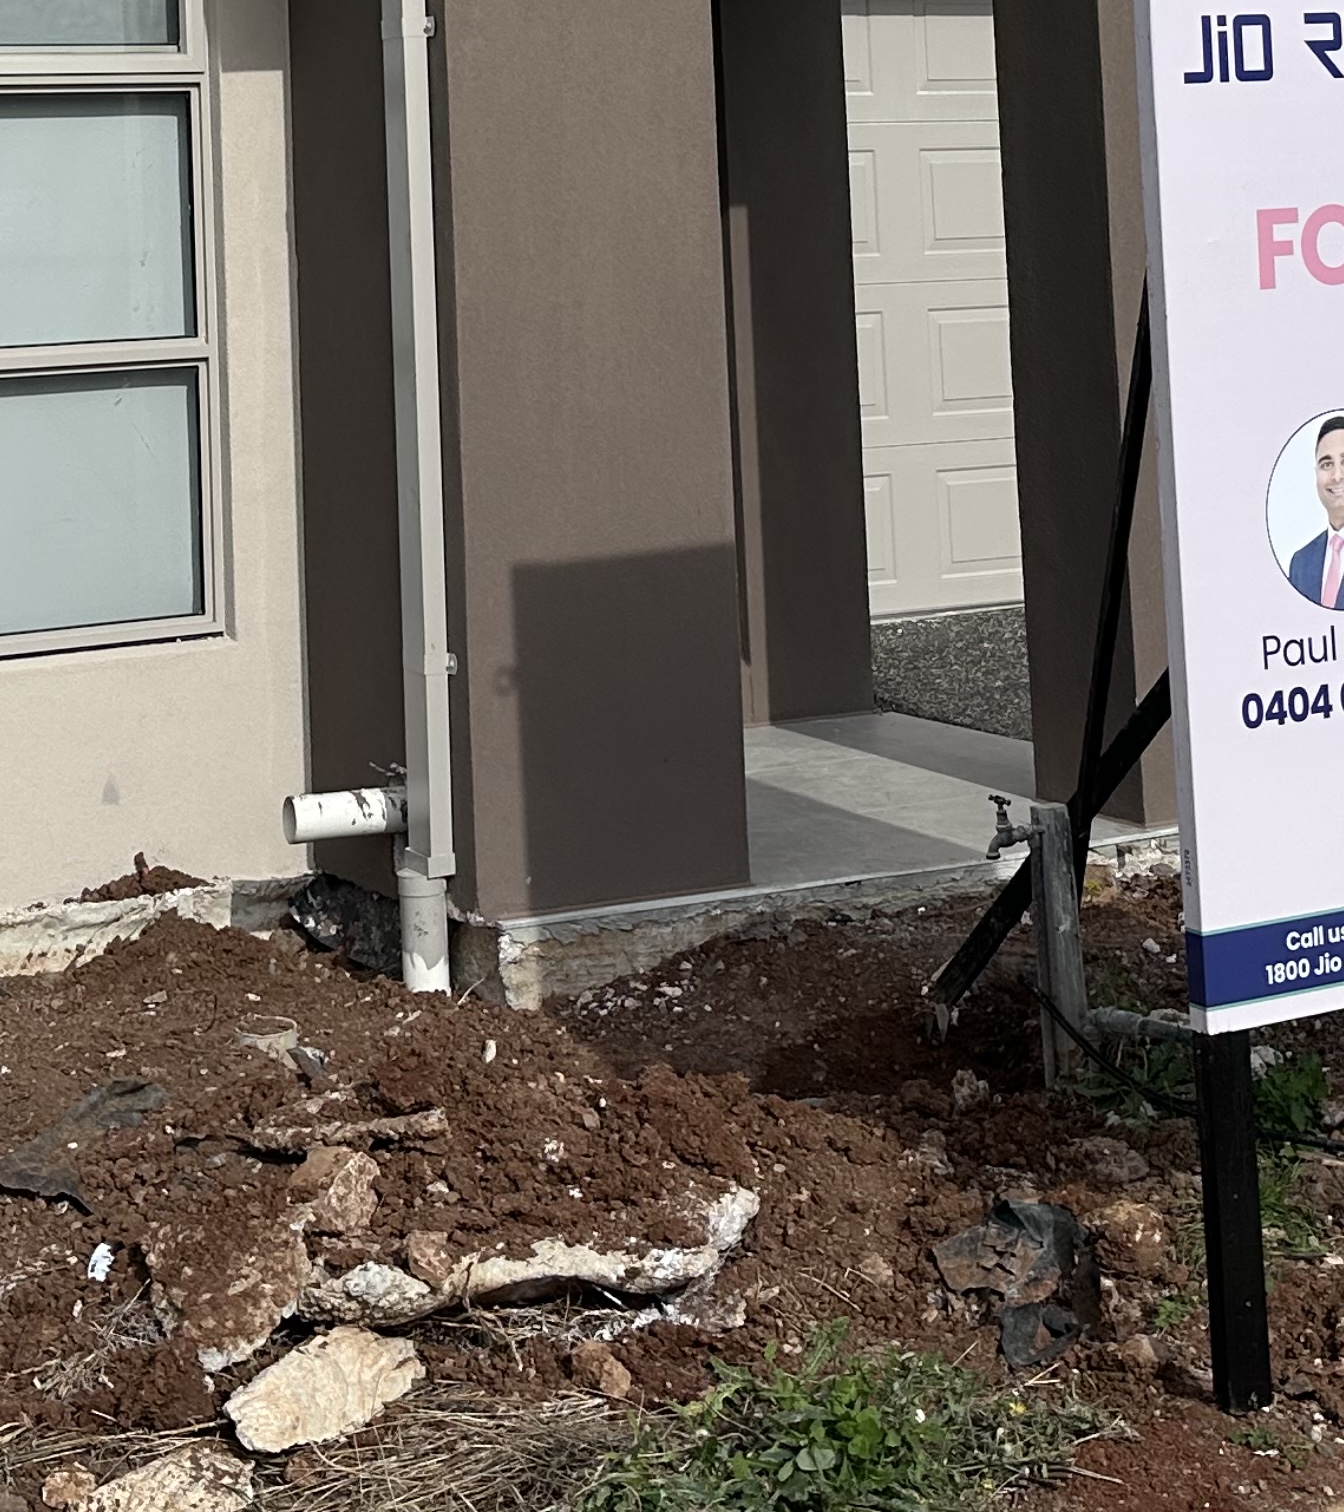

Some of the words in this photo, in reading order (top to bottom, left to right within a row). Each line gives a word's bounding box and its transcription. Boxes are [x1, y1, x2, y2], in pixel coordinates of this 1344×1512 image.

[1262, 626, 1338, 670] Paul
[1241, 684, 1334, 730] 0404
[1286, 925, 1324, 951] Call
[1265, 958, 1310, 985] 1800
[1314, 952, 1342, 976] Jio
